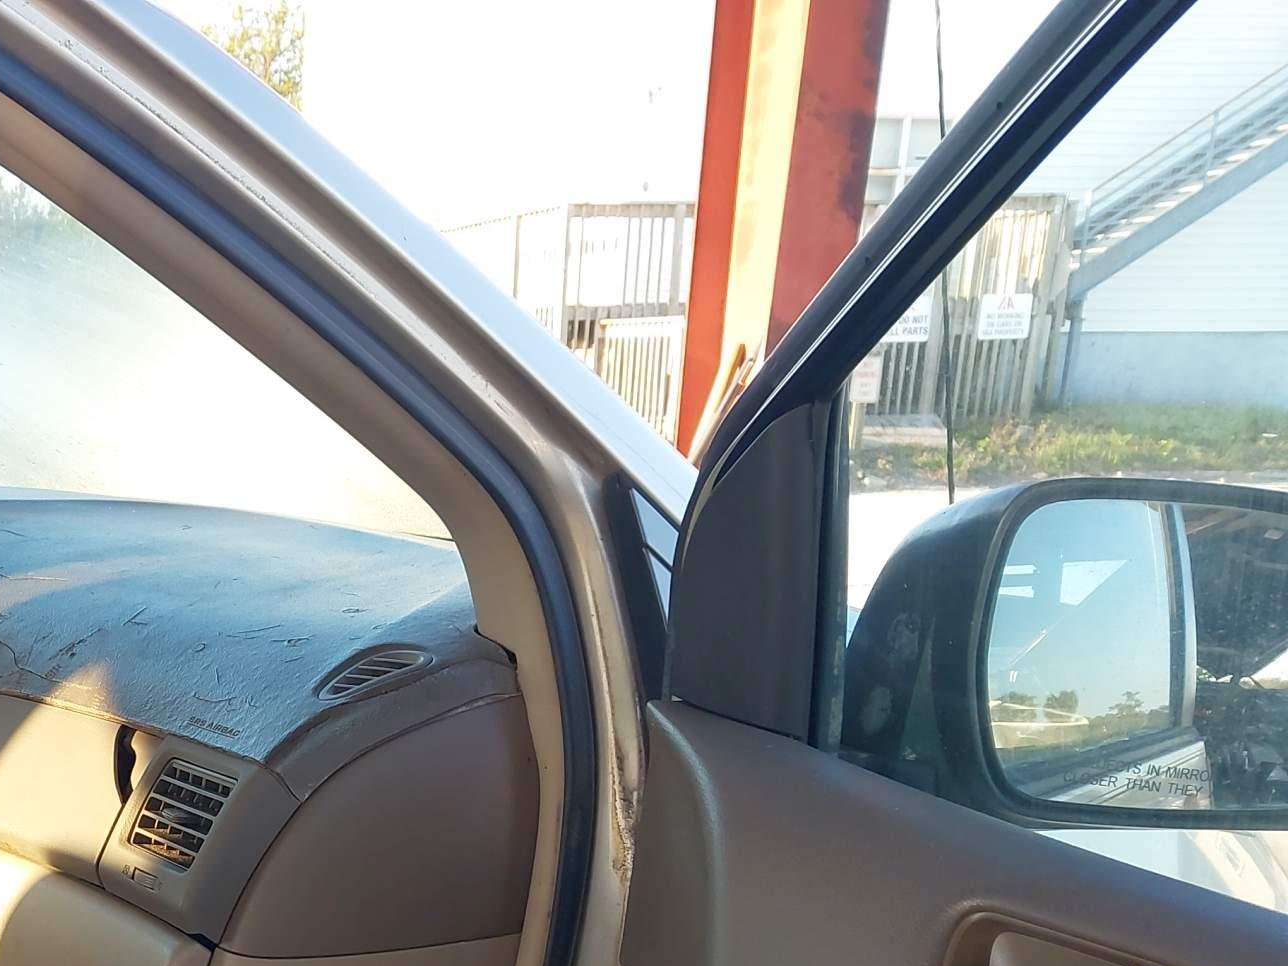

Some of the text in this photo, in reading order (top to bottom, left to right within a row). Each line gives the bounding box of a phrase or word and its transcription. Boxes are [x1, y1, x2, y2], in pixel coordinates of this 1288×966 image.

[912, 315, 928, 324] NOT
[902, 327, 928, 336] PARTS
[207, 721, 241, 737] AIRBAG
[1146, 763, 1161, 777] IN
[1164, 766, 1210, 782] MIRRO
[1125, 777, 1161, 792] THAN
[1167, 782, 1203, 797] THEY
